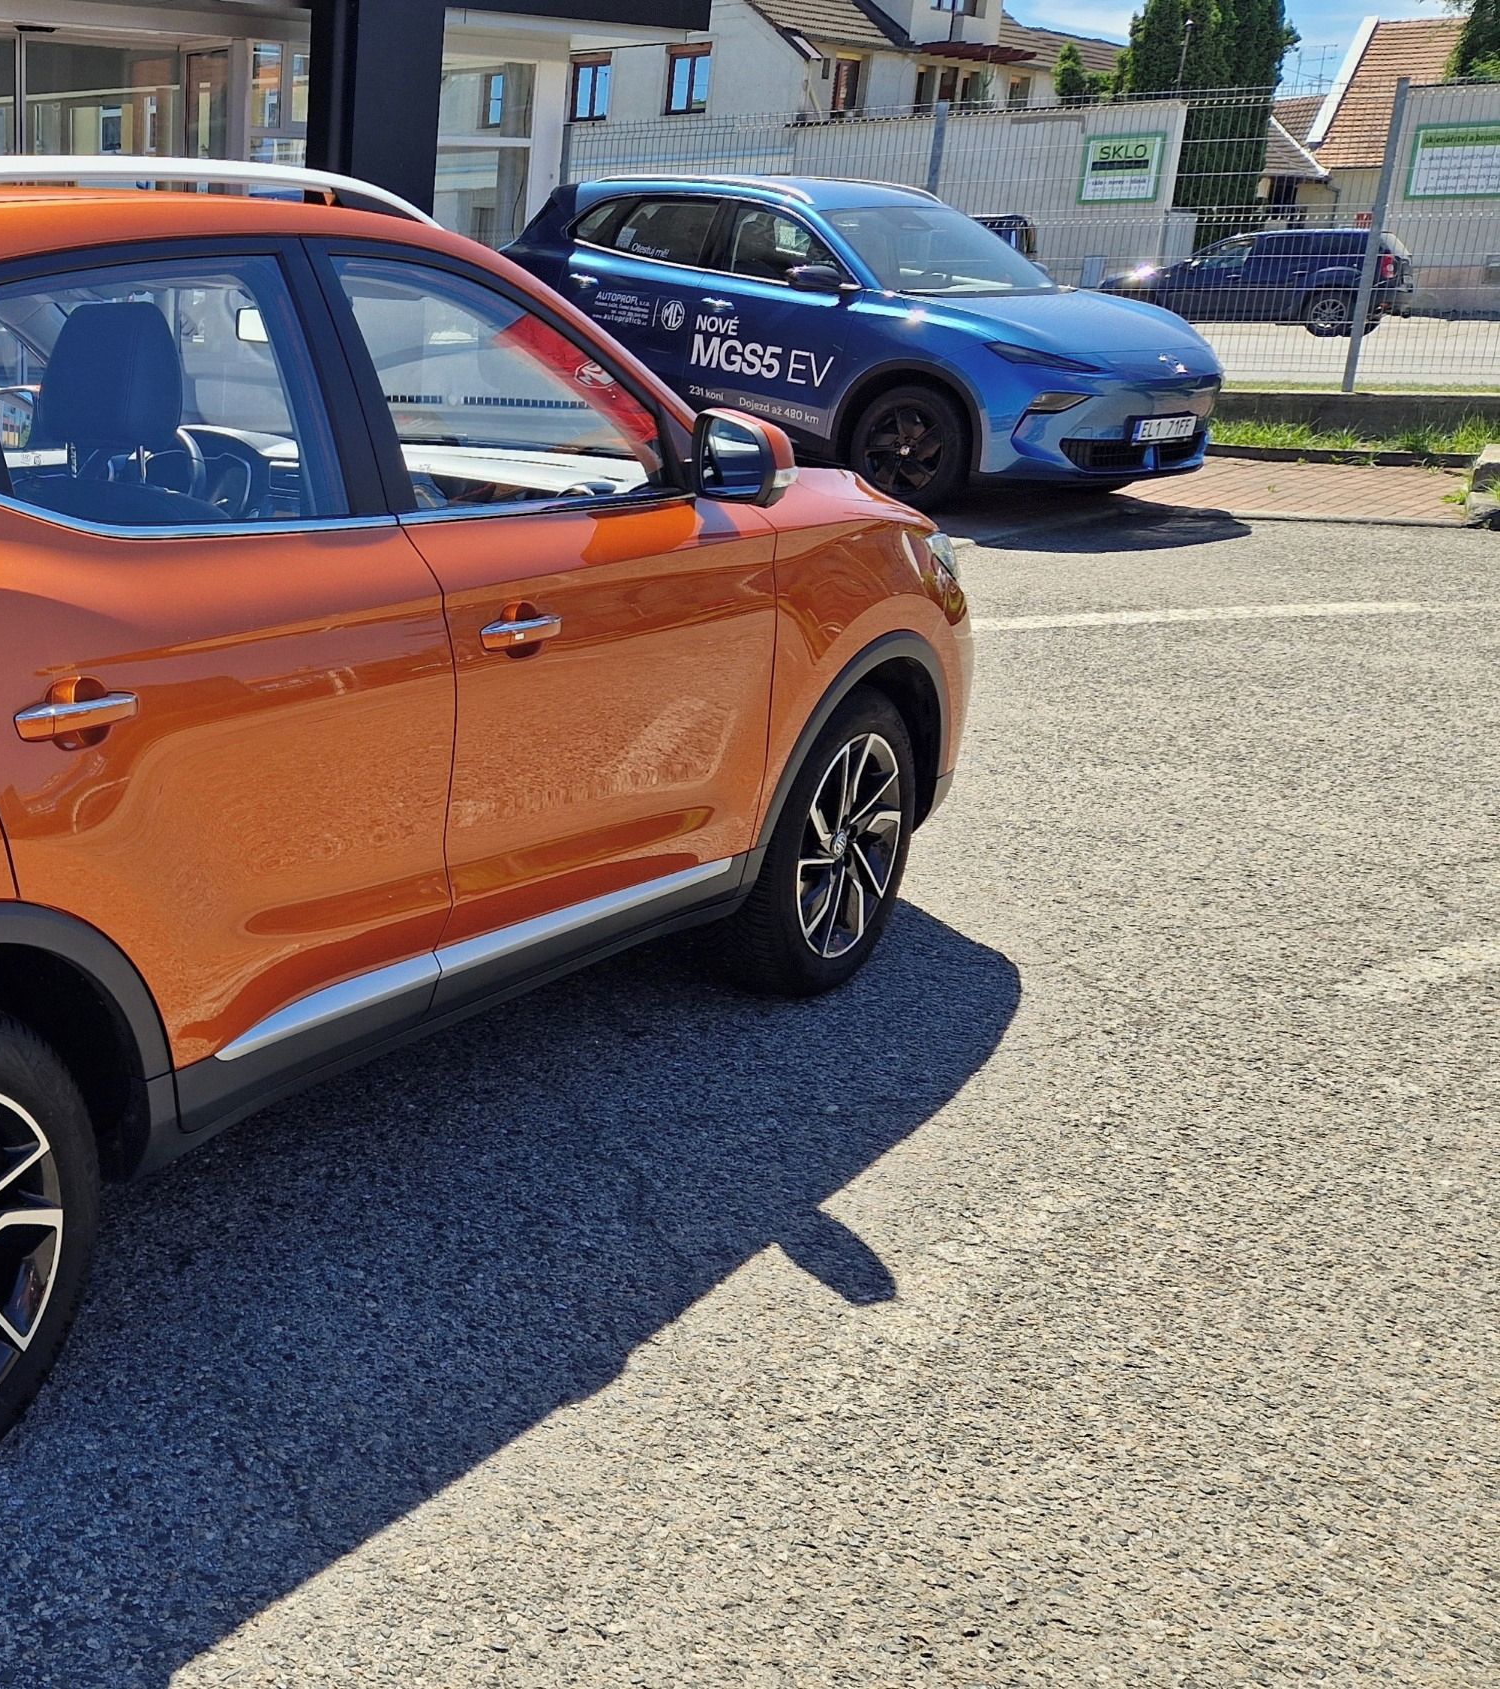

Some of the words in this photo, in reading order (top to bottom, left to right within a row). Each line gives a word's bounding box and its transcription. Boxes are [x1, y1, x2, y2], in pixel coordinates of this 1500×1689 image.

[1099, 144, 1147, 160] SKLO
[662, 302, 684, 329] MG
[695, 314, 740, 336] NOVÉ
[690, 333, 783, 379] MGS5
[786, 349, 835, 388] EV
[689, 384, 704, 396] 231
[739, 397, 770, 413] Dojezd
[783, 408, 803, 421] 480
[804, 411, 820, 425] km
[1141, 421, 1162, 438] EL1
[1166, 418, 1192, 437] 71FF
